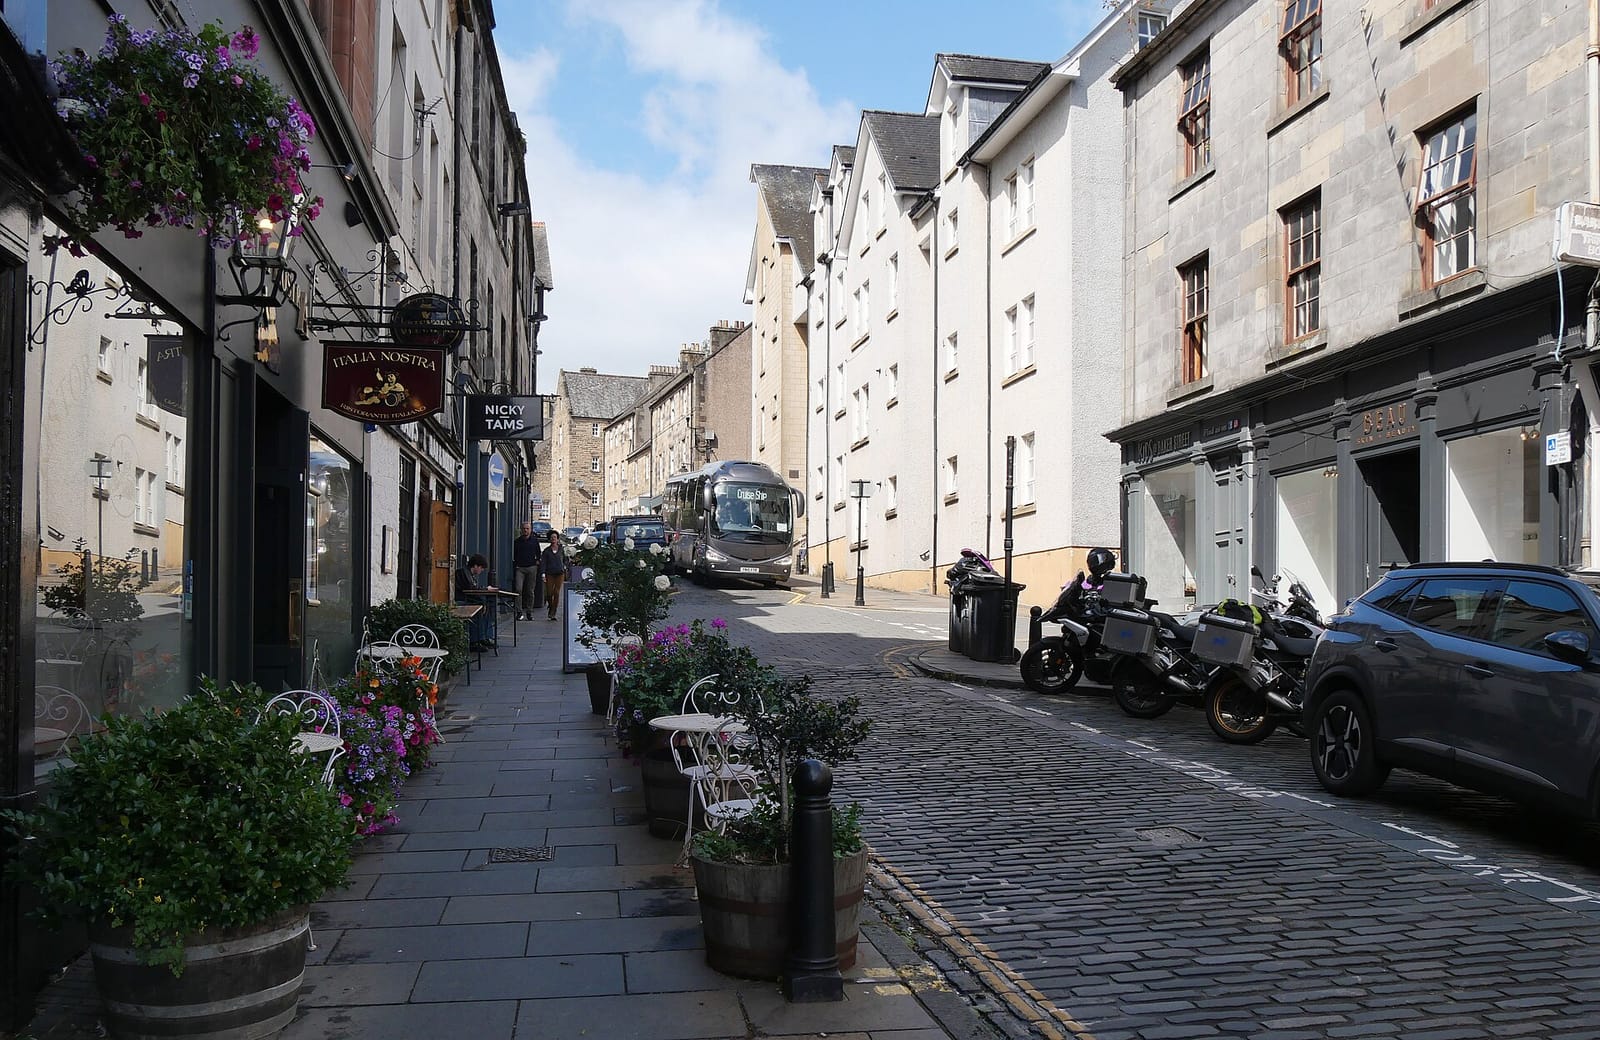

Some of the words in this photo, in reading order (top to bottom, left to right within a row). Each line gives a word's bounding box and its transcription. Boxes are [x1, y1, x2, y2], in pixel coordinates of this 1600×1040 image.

[333, 351, 376, 368] ITALIA
[380, 351, 436, 371] NOSTRA
[339, 402, 389, 419] RISTORANTE
[391, 405, 427, 419] ITALIANO
[485, 404, 525, 416] NICKY
[485, 419, 525, 430] TAMS
[1363, 403, 1405, 433] BEAU
[1386, 425, 1415, 438] BEAUTY
[1174, 432, 1190, 449] STREET
[736, 488, 755, 499] Cruise
[755, 490, 767, 501] Ship
